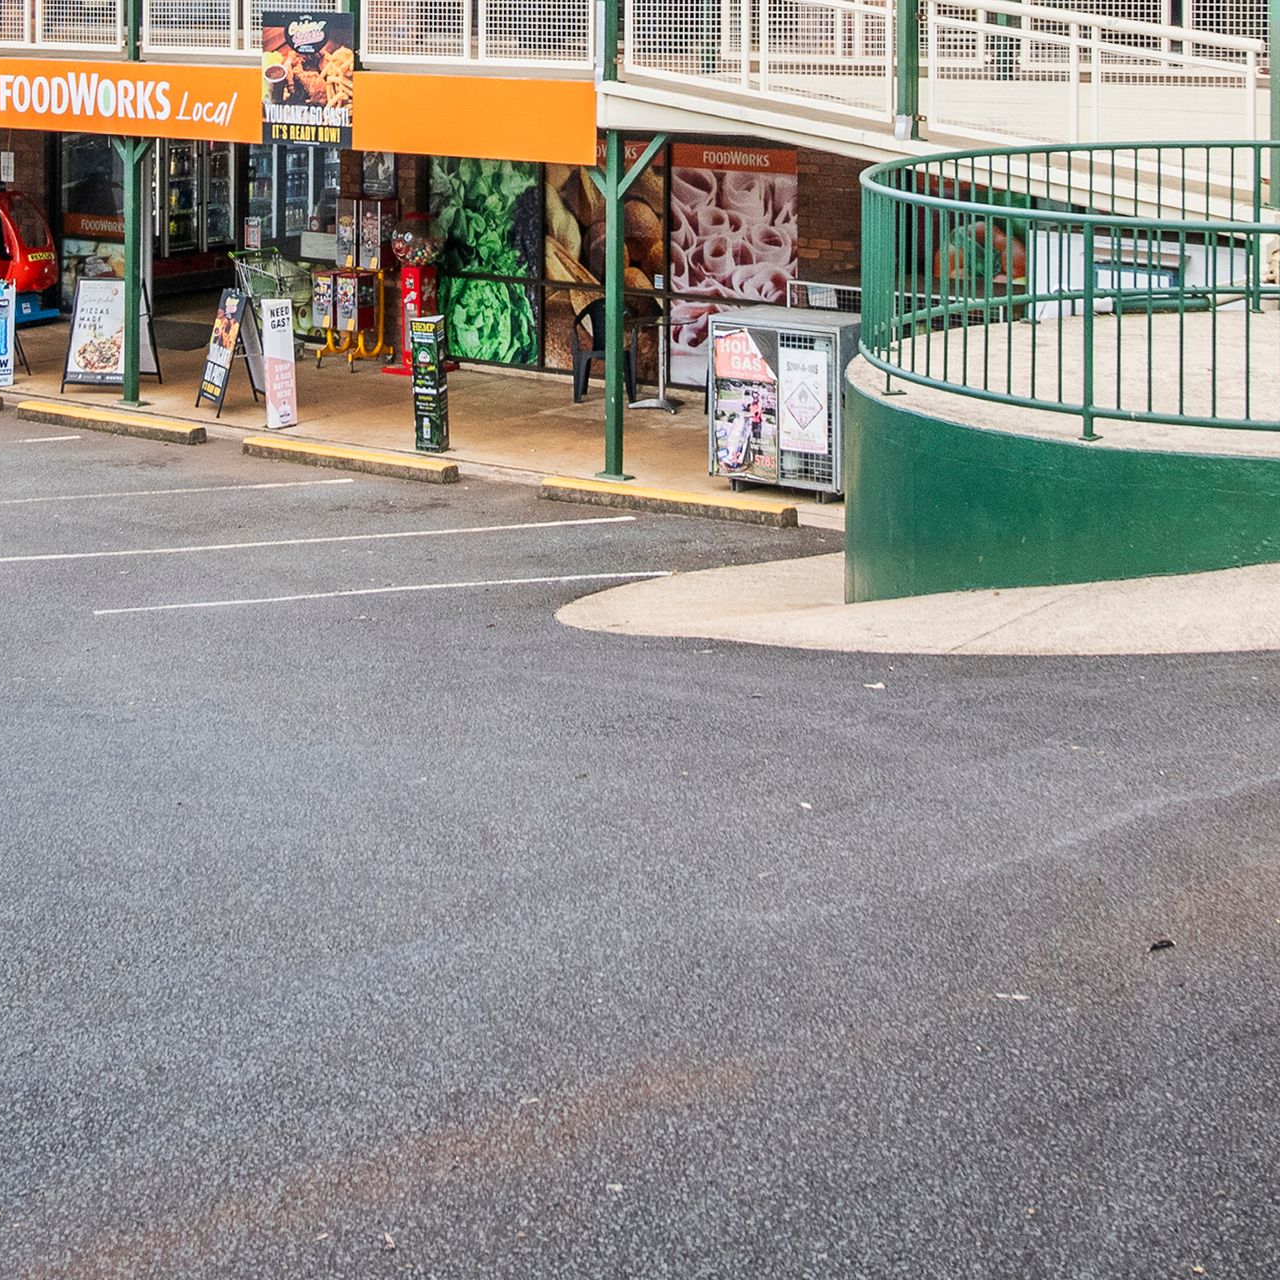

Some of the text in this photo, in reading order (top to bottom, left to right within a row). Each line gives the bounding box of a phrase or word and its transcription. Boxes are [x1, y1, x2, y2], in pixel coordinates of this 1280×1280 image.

[176, 91, 238, 127] Local
[271, 124, 340, 143] IT'S READY NOW!
[80, 307, 110, 315] PIZZAS
[269, 305, 290, 319] NEED
[270, 317, 290, 330] GAS?
[412, 322, 436, 332] HEMP
[731, 356, 762, 371] GAS
